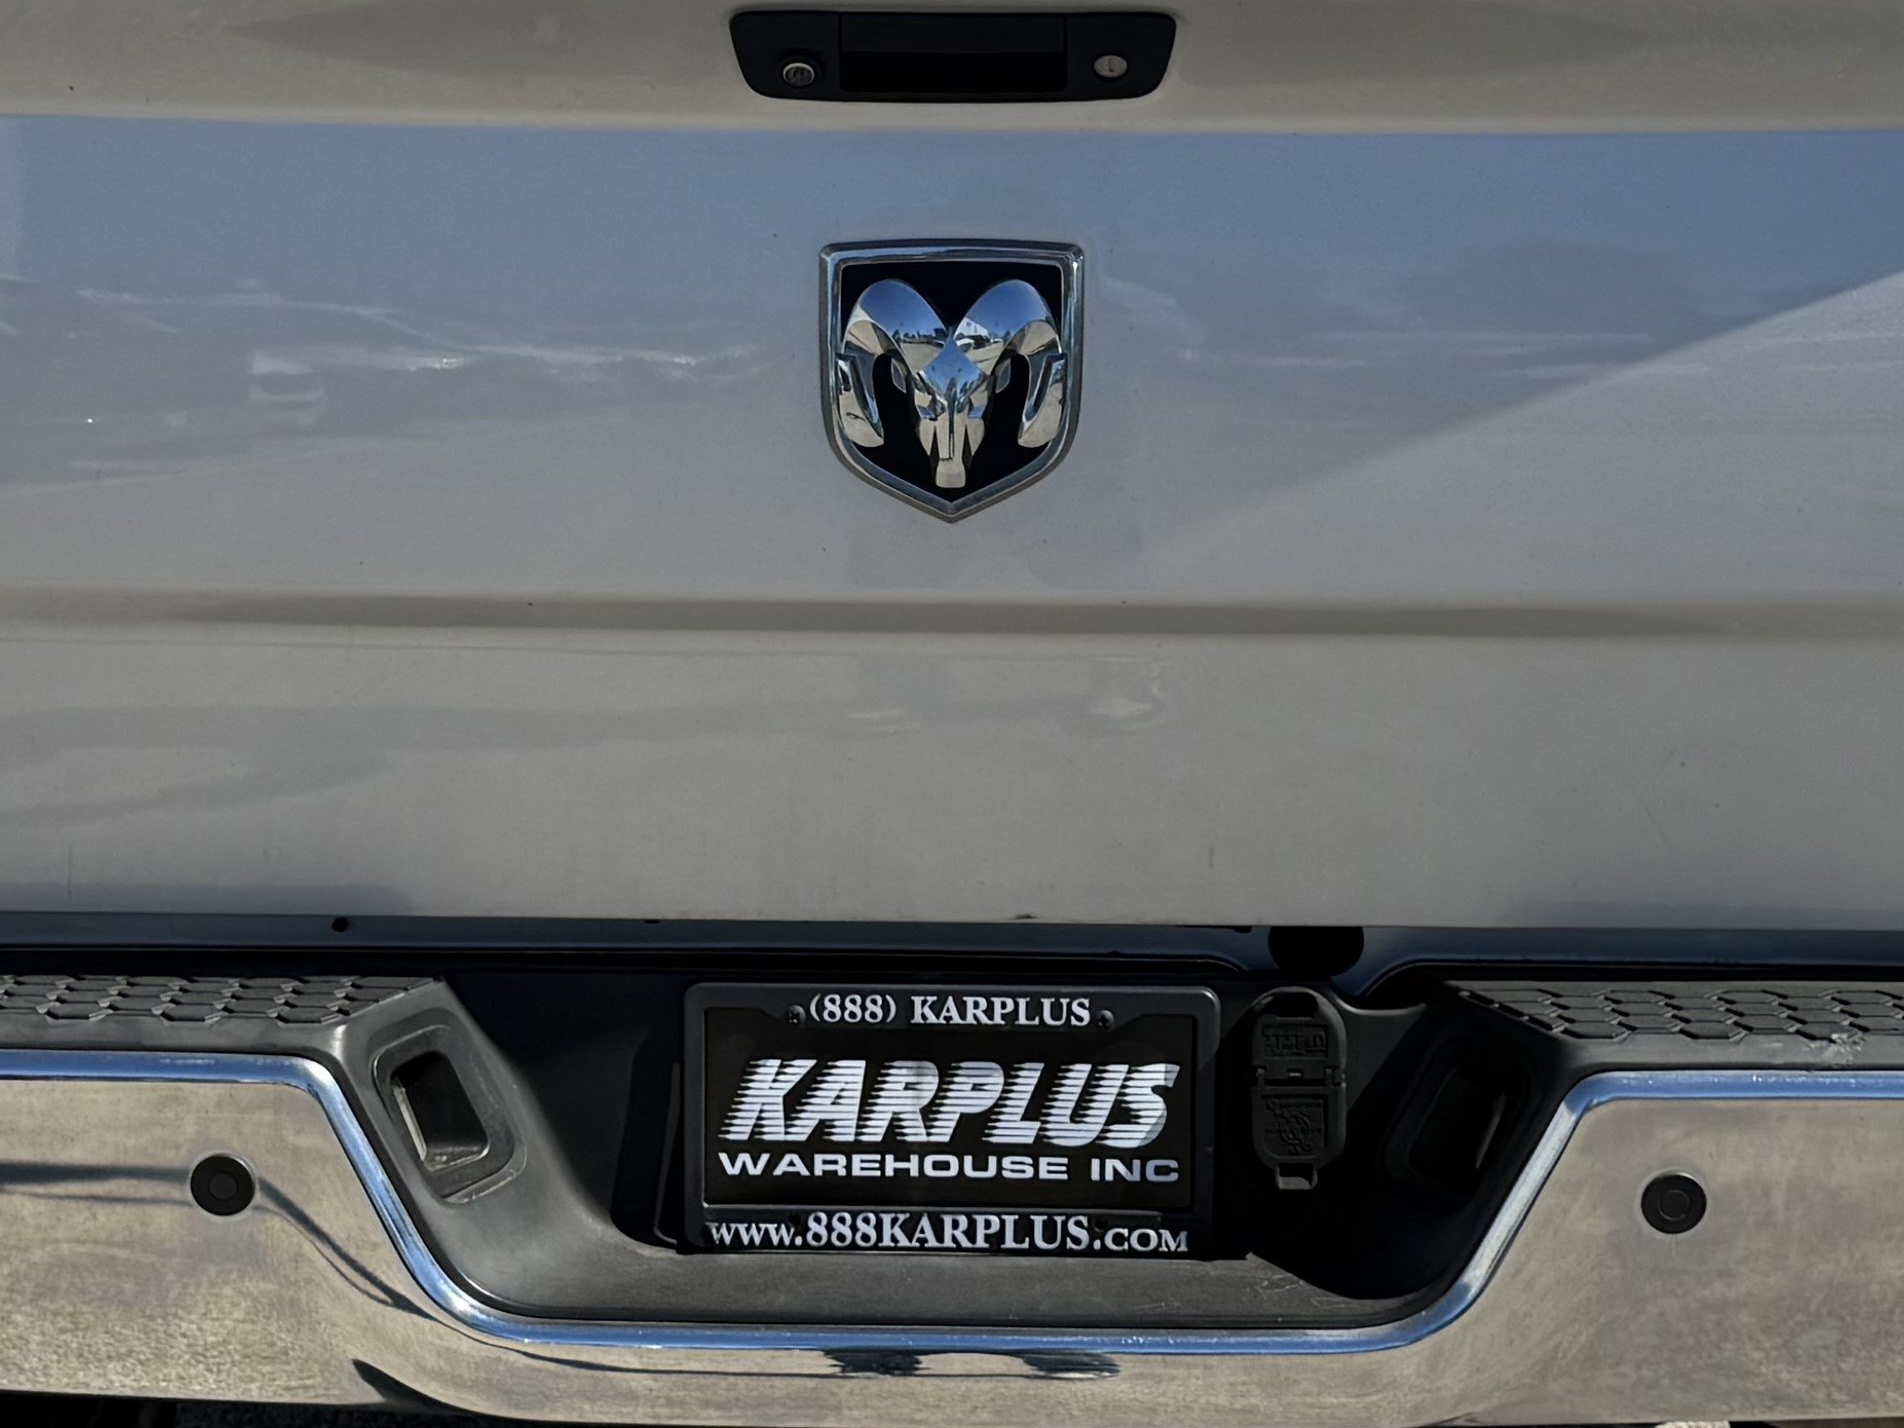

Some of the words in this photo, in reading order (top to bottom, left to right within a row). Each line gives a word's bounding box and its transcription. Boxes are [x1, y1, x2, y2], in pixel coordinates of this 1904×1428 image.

[808, 992, 897, 1027] (888)
[910, 996, 1092, 1027] KARPLUS
[717, 1058, 1181, 1149] KARPLUS
[717, 1151, 1070, 1181] WAREHOUSE
[1089, 1156, 1181, 1183] INC
